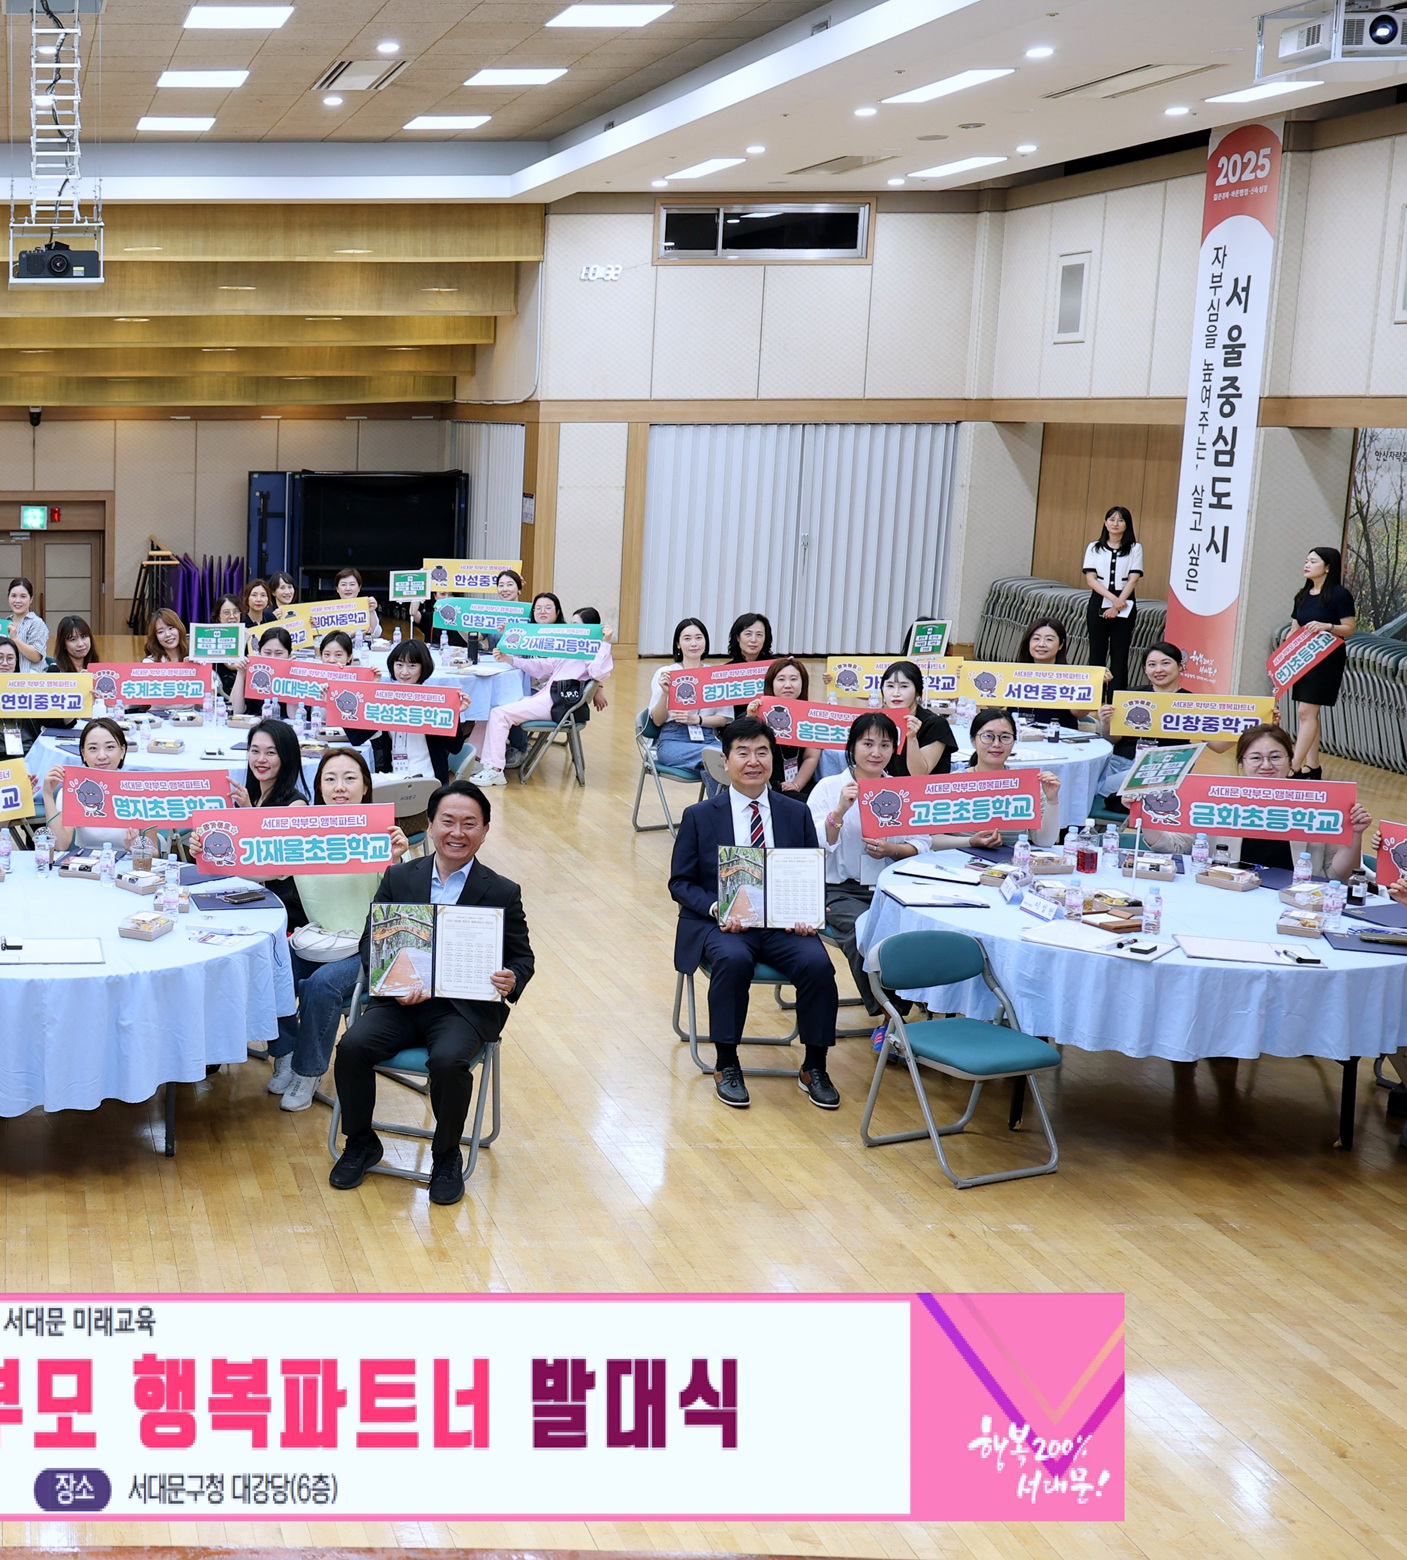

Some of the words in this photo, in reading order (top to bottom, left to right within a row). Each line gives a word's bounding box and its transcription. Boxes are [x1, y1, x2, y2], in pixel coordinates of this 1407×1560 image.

[1214, 147, 1271, 186] 2025
[1204, 244, 1228, 350] 자부심을
[1205, 274, 1252, 563] 서울중심도시
[1189, 484, 1205, 532] 살고
[1185, 543, 1200, 592] 싶은
[520, 637, 602, 655] 가재울고등학교
[1275, 633, 1335, 684] 연가초등학교
[132, 668, 148, 676] 서대문
[168, 668, 196, 676] 행복파트너
[1035, 671, 1054, 679] 학부모
[1056, 672, 1089, 680] 행복파트너
[8, 680, 26, 688] 서대문
[28, 680, 45, 688] 학부모
[47, 680, 76, 688] 행복파트너
[123, 681, 203, 697] 추계초등학교
[1005, 683, 1092, 701] 서연중학교
[1, 694, 82, 710] 연희중학교
[376, 690, 394, 699] 서대문
[414, 693, 445, 702] 행복파트너
[809, 709, 829, 718] 서대문
[1172, 701, 1193, 709] 서대문
[1196, 702, 1217, 710] 학부모
[1219, 703, 1255, 711] 행복파트너
[366, 704, 453, 727] 북성초등학교
[1163, 714, 1260, 734] 인창중학교
[121, 781, 142, 790] 서대문
[144, 781, 168, 790] 학부모
[169, 780, 209, 790] 행복파트너
[925, 783, 951, 795] 서대문
[952, 781, 976, 792] 학부모
[978, 778, 1019, 791] 행복파트너
[1209, 785, 1240, 798] 서대문
[1243, 788, 1272, 800] 학부모
[1274, 788, 1327, 802] 행복파트너
[910, 796, 1033, 825] 고은초등학교
[1192, 804, 1342, 832] 금화초등학교
[262, 818, 289, 829] 서대문
[291, 817, 319, 828] 학부모
[321, 815, 366, 826] 행복파트너
[241, 835, 390, 862] 가재울초등학교
